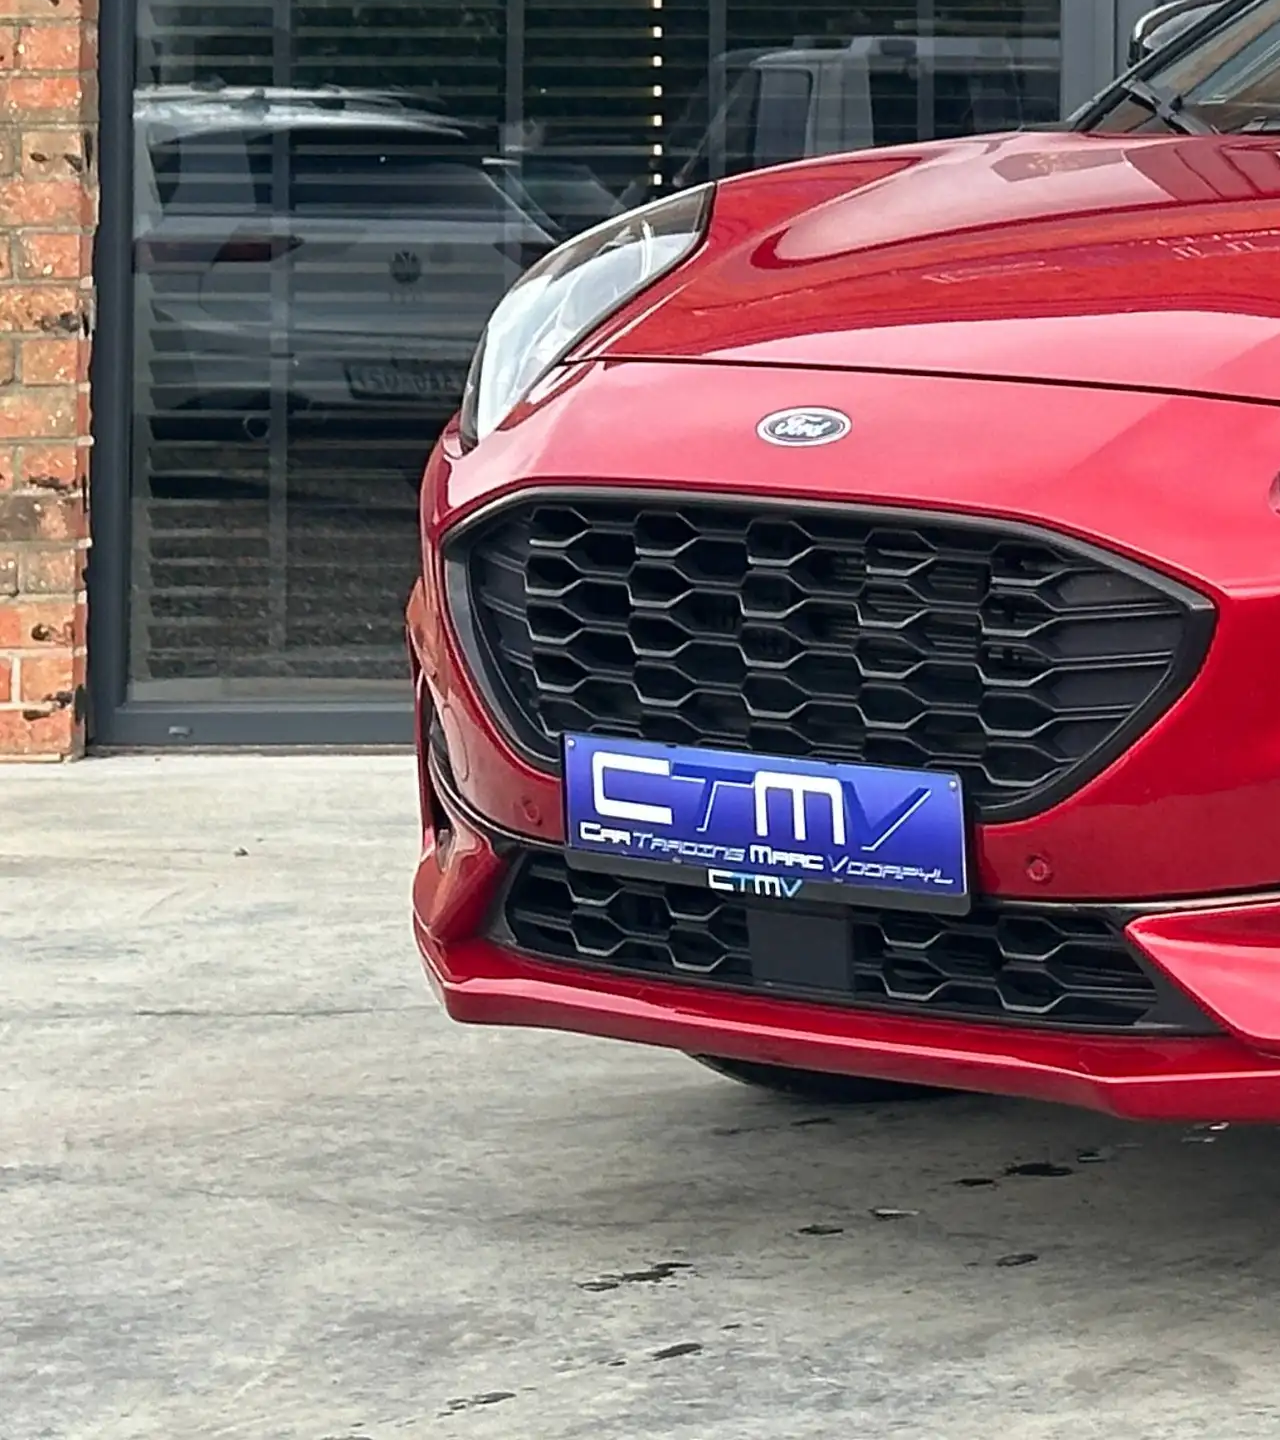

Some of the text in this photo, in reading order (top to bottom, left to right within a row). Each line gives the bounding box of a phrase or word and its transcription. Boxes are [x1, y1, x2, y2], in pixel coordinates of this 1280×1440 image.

[775, 415, 832, 437] Ford
[592, 751, 932, 852] CTMV
[707, 867, 802, 898] CTMV
